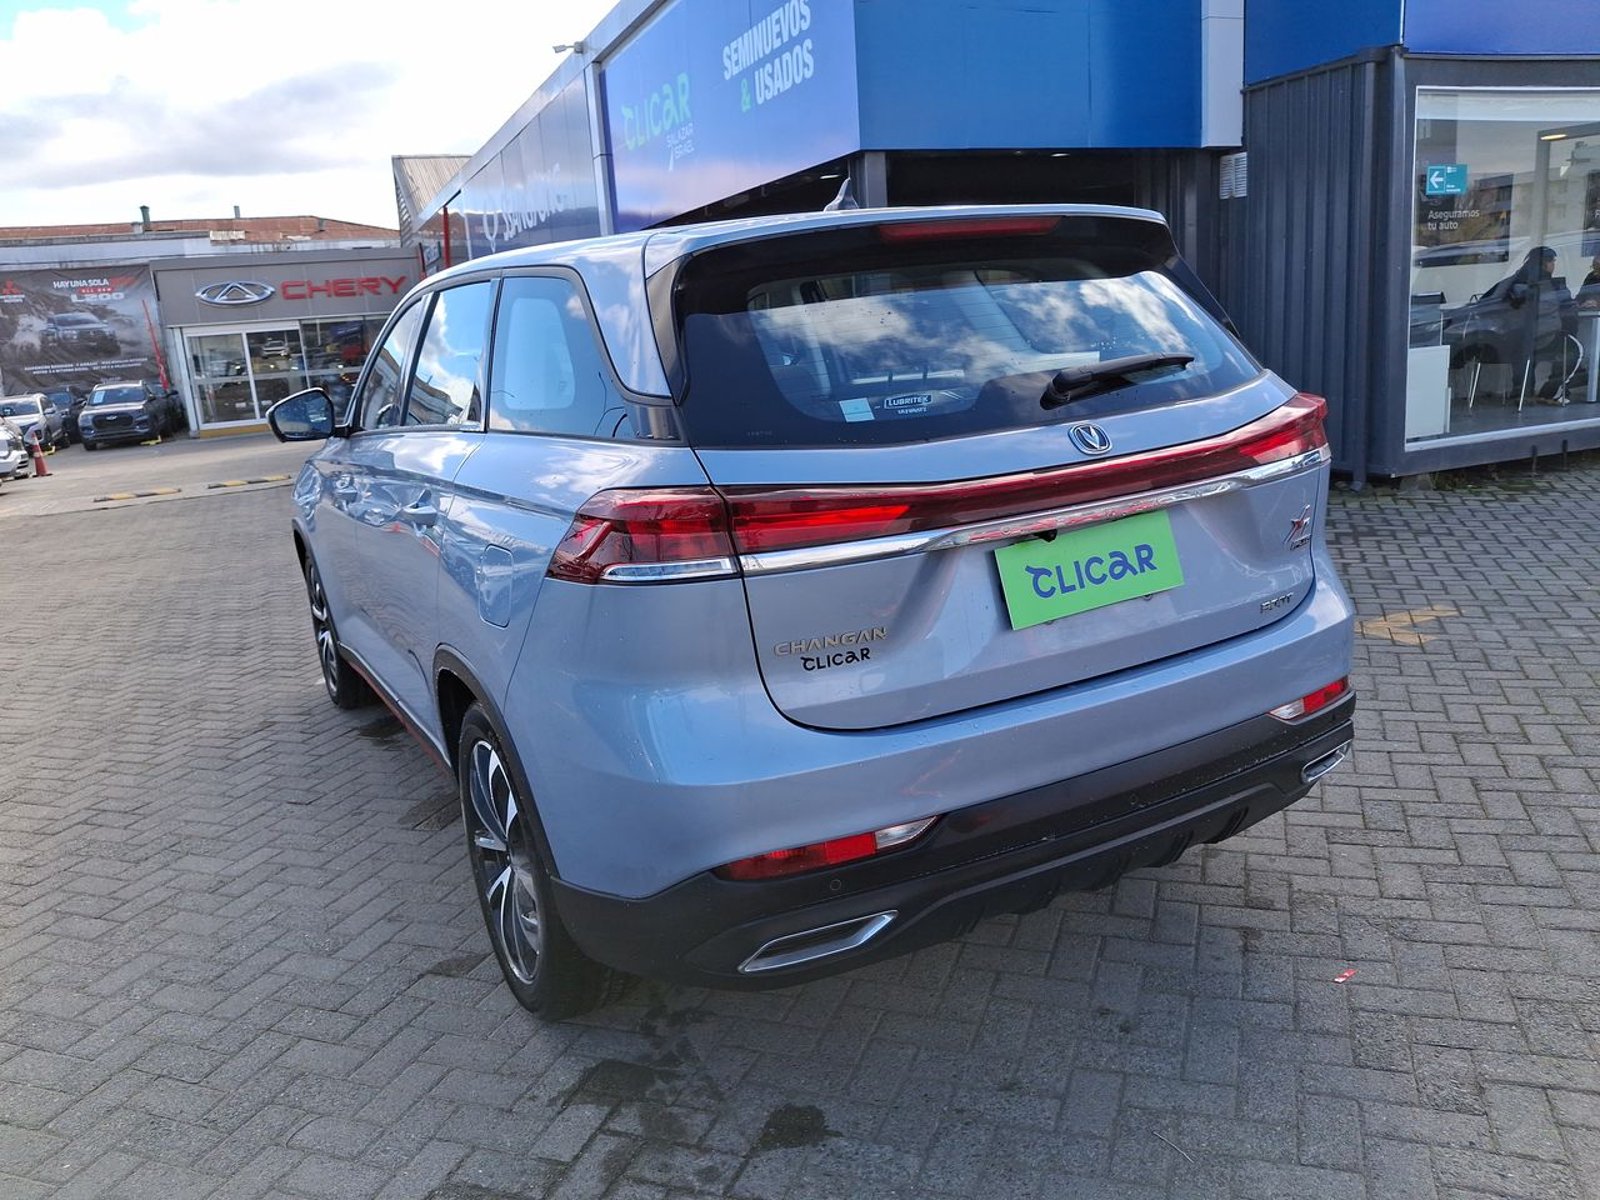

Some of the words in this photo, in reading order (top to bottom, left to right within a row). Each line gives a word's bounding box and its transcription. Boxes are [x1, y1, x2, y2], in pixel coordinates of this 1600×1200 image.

[723, 0, 811, 80] SEMINUEVOS
[741, 78, 752, 112] &
[755, 38, 815, 105] USADOS
[1428, 209, 1480, 221] Aseguramos
[1428, 221, 1437, 231] tu
[1438, 220, 1459, 231] auto
[53, 279, 70, 289] HAY
[70, 279, 88, 288] UNA
[88, 278, 110, 287] SOLA
[281, 275, 407, 300] CHERY
[774, 626, 887, 657] CHANGAN
